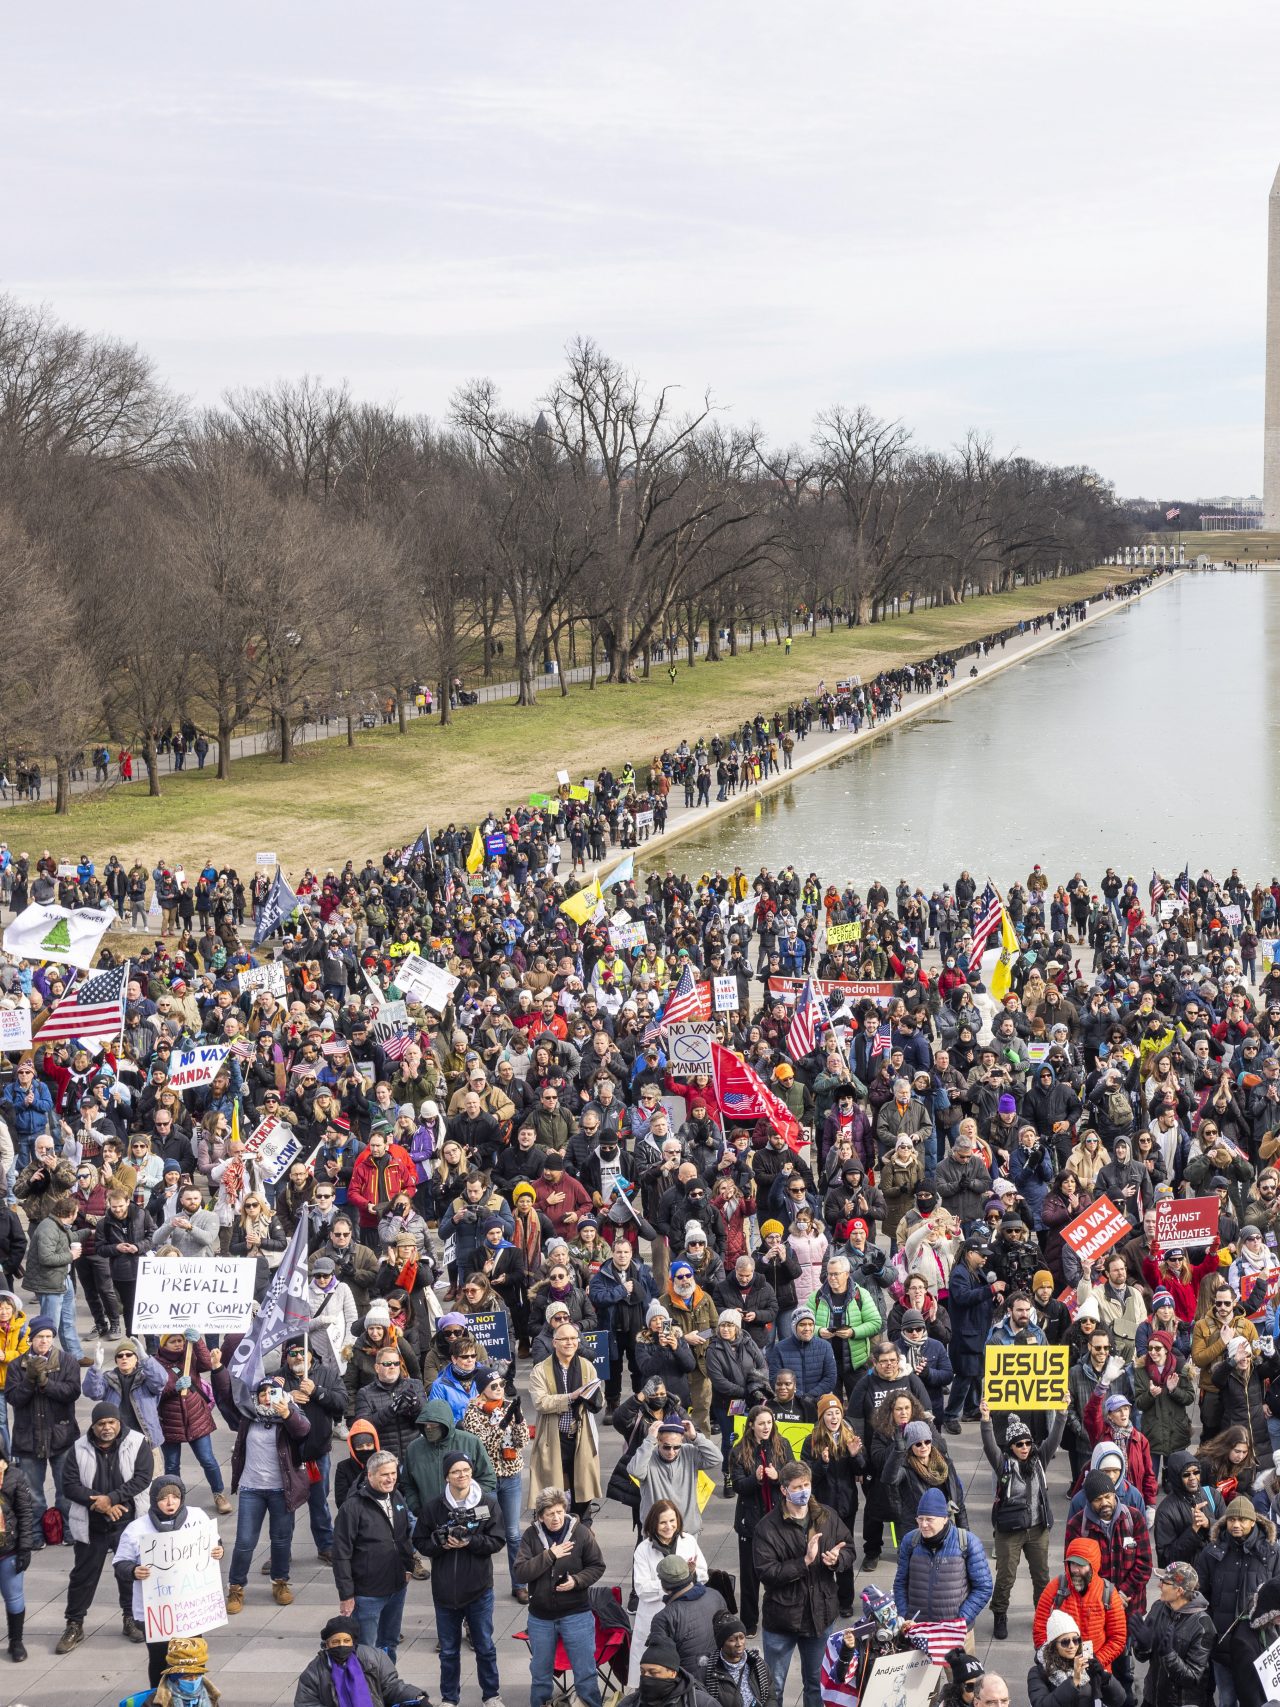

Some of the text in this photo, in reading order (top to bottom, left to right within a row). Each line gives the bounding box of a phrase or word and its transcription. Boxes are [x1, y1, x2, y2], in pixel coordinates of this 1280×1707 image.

[828, 984, 879, 994] Freedom!
[670, 1023, 716, 1036] NO VAX
[180, 1052, 195, 1066] NO
[672, 1062, 712, 1074] MANDATE
[1069, 1203, 1112, 1244] NO VAX
[1159, 1212, 1200, 1224] AGAINST
[1158, 1223, 1178, 1233] VAX
[1158, 1228, 1211, 1241] MANDATES
[1076, 1214, 1128, 1260] MANDATE
[214, 1263, 240, 1273] NOT
[161, 1278, 238, 1293] PREVAIL!
[137, 1302, 252, 1315] DO NOT COMPLY
[990, 1350, 1064, 1376] JESUS
[988, 1379, 1064, 1405] SAVES
[155, 1531, 211, 1571] Liberty
[156, 1574, 216, 1597] for ALL
[147, 1592, 233, 1638] NO MANDATES
[875, 1669, 890, 1677] And
[890, 1665, 904, 1676] just
[966, 1662, 984, 1673] NY
